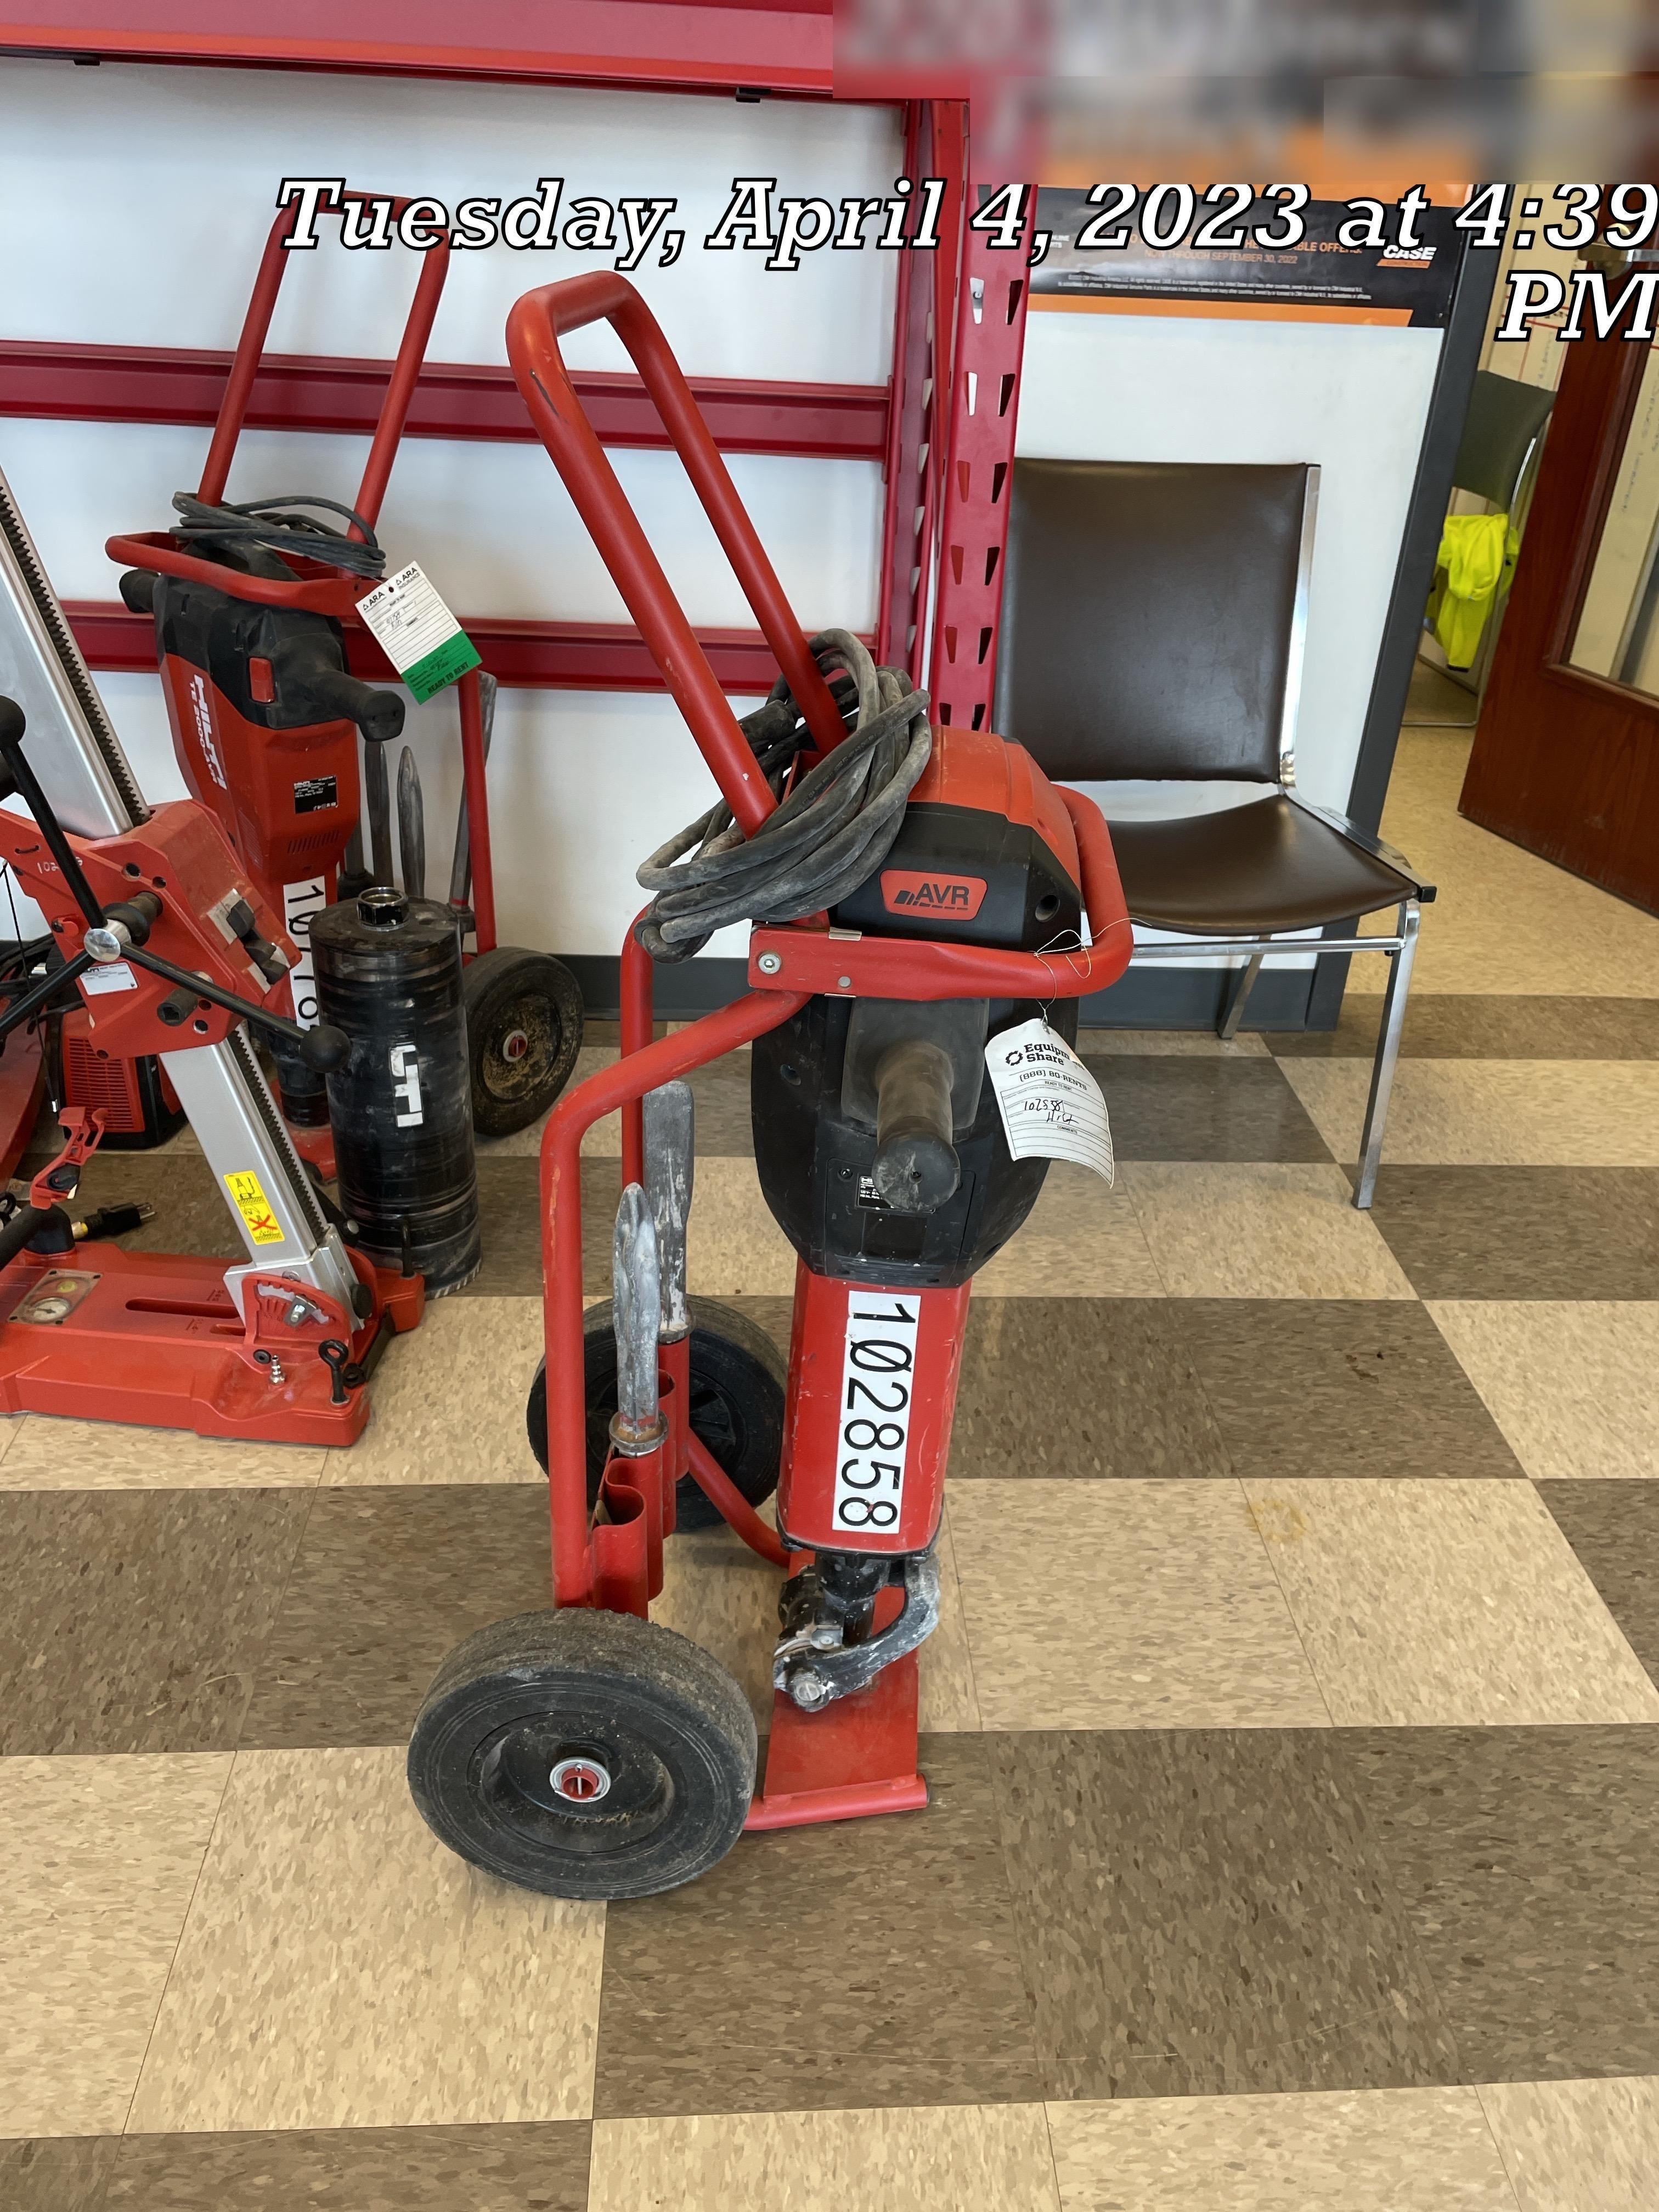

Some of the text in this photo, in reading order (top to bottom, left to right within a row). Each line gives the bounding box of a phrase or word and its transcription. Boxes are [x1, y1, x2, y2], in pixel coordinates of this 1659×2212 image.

[1169, 250, 1210, 261] THROUGH
[1211, 252, 1262, 262] SEPTEMBER
[1277, 254, 1299, 264] 2022
[1383, 244, 1437, 261] CASE
[402, 567, 417, 581] ARA
[369, 591, 385, 606] ARA
[194, 674, 228, 791] HILTI
[915, 883, 970, 906] AVR
[1026, 1052, 1064, 1066] Share
[1019, 1069, 1087, 1091] (888) 80-RENTS
[838, 1302, 917, 1527] 102858
